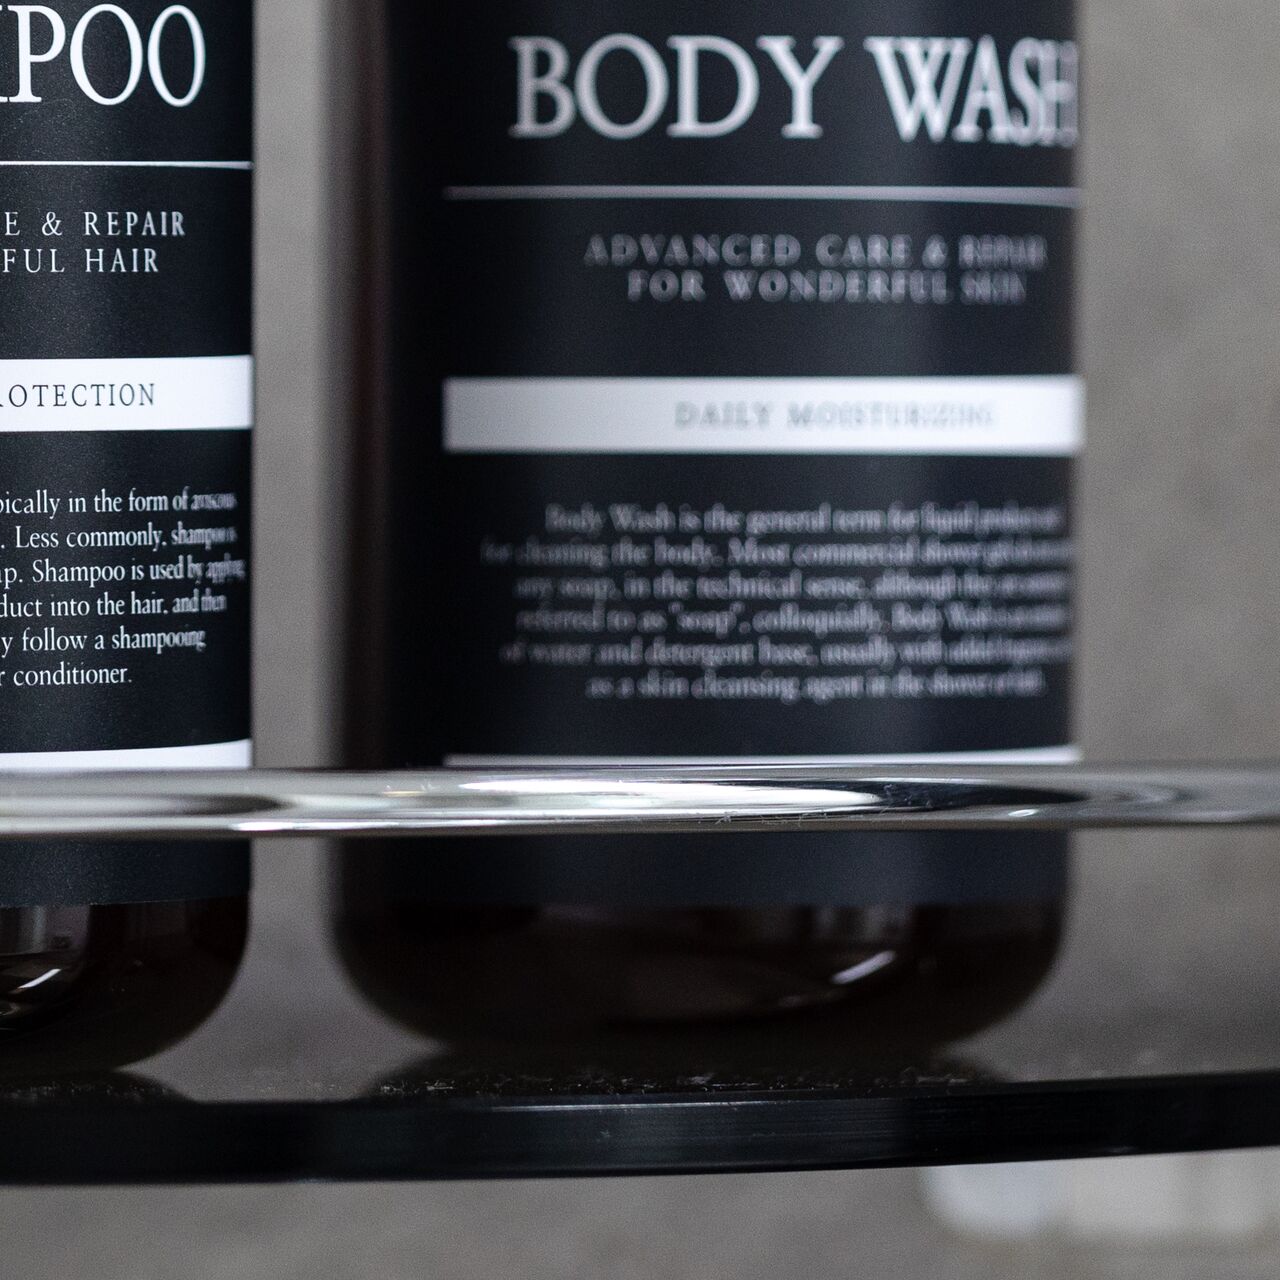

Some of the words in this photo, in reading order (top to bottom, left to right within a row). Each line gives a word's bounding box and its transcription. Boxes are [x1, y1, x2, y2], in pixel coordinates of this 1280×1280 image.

[508, 32, 843, 140] BODY
[864, 34, 1078, 147] WASH
[41, 211, 63, 237] &
[83, 211, 185, 236] REPAIR
[84, 247, 159, 273] HAIR
[583, 234, 802, 266] ADVANCED
[815, 233, 912, 267] CARE
[626, 270, 707, 303] FOR
[724, 270, 953, 304] WONDERFUL
[674, 400, 773, 429] DAILY
[68, 488, 87, 514] in
[93, 487, 123, 513] the
[128, 487, 169, 512] form
[171, 485, 189, 511] of
[15, 525, 60, 549] Less
[32, 557, 126, 589] Shampoo
[130, 557, 145, 582] is
[149, 554, 185, 581] used
[50, 592, 91, 618] into
[96, 591, 126, 616] the
[171, 587, 200, 614] and
[21, 626, 88, 652] follow
[93, 634, 105, 651] a
[111, 624, 206, 655] shampooing
[12, 660, 133, 688] conditioner.
